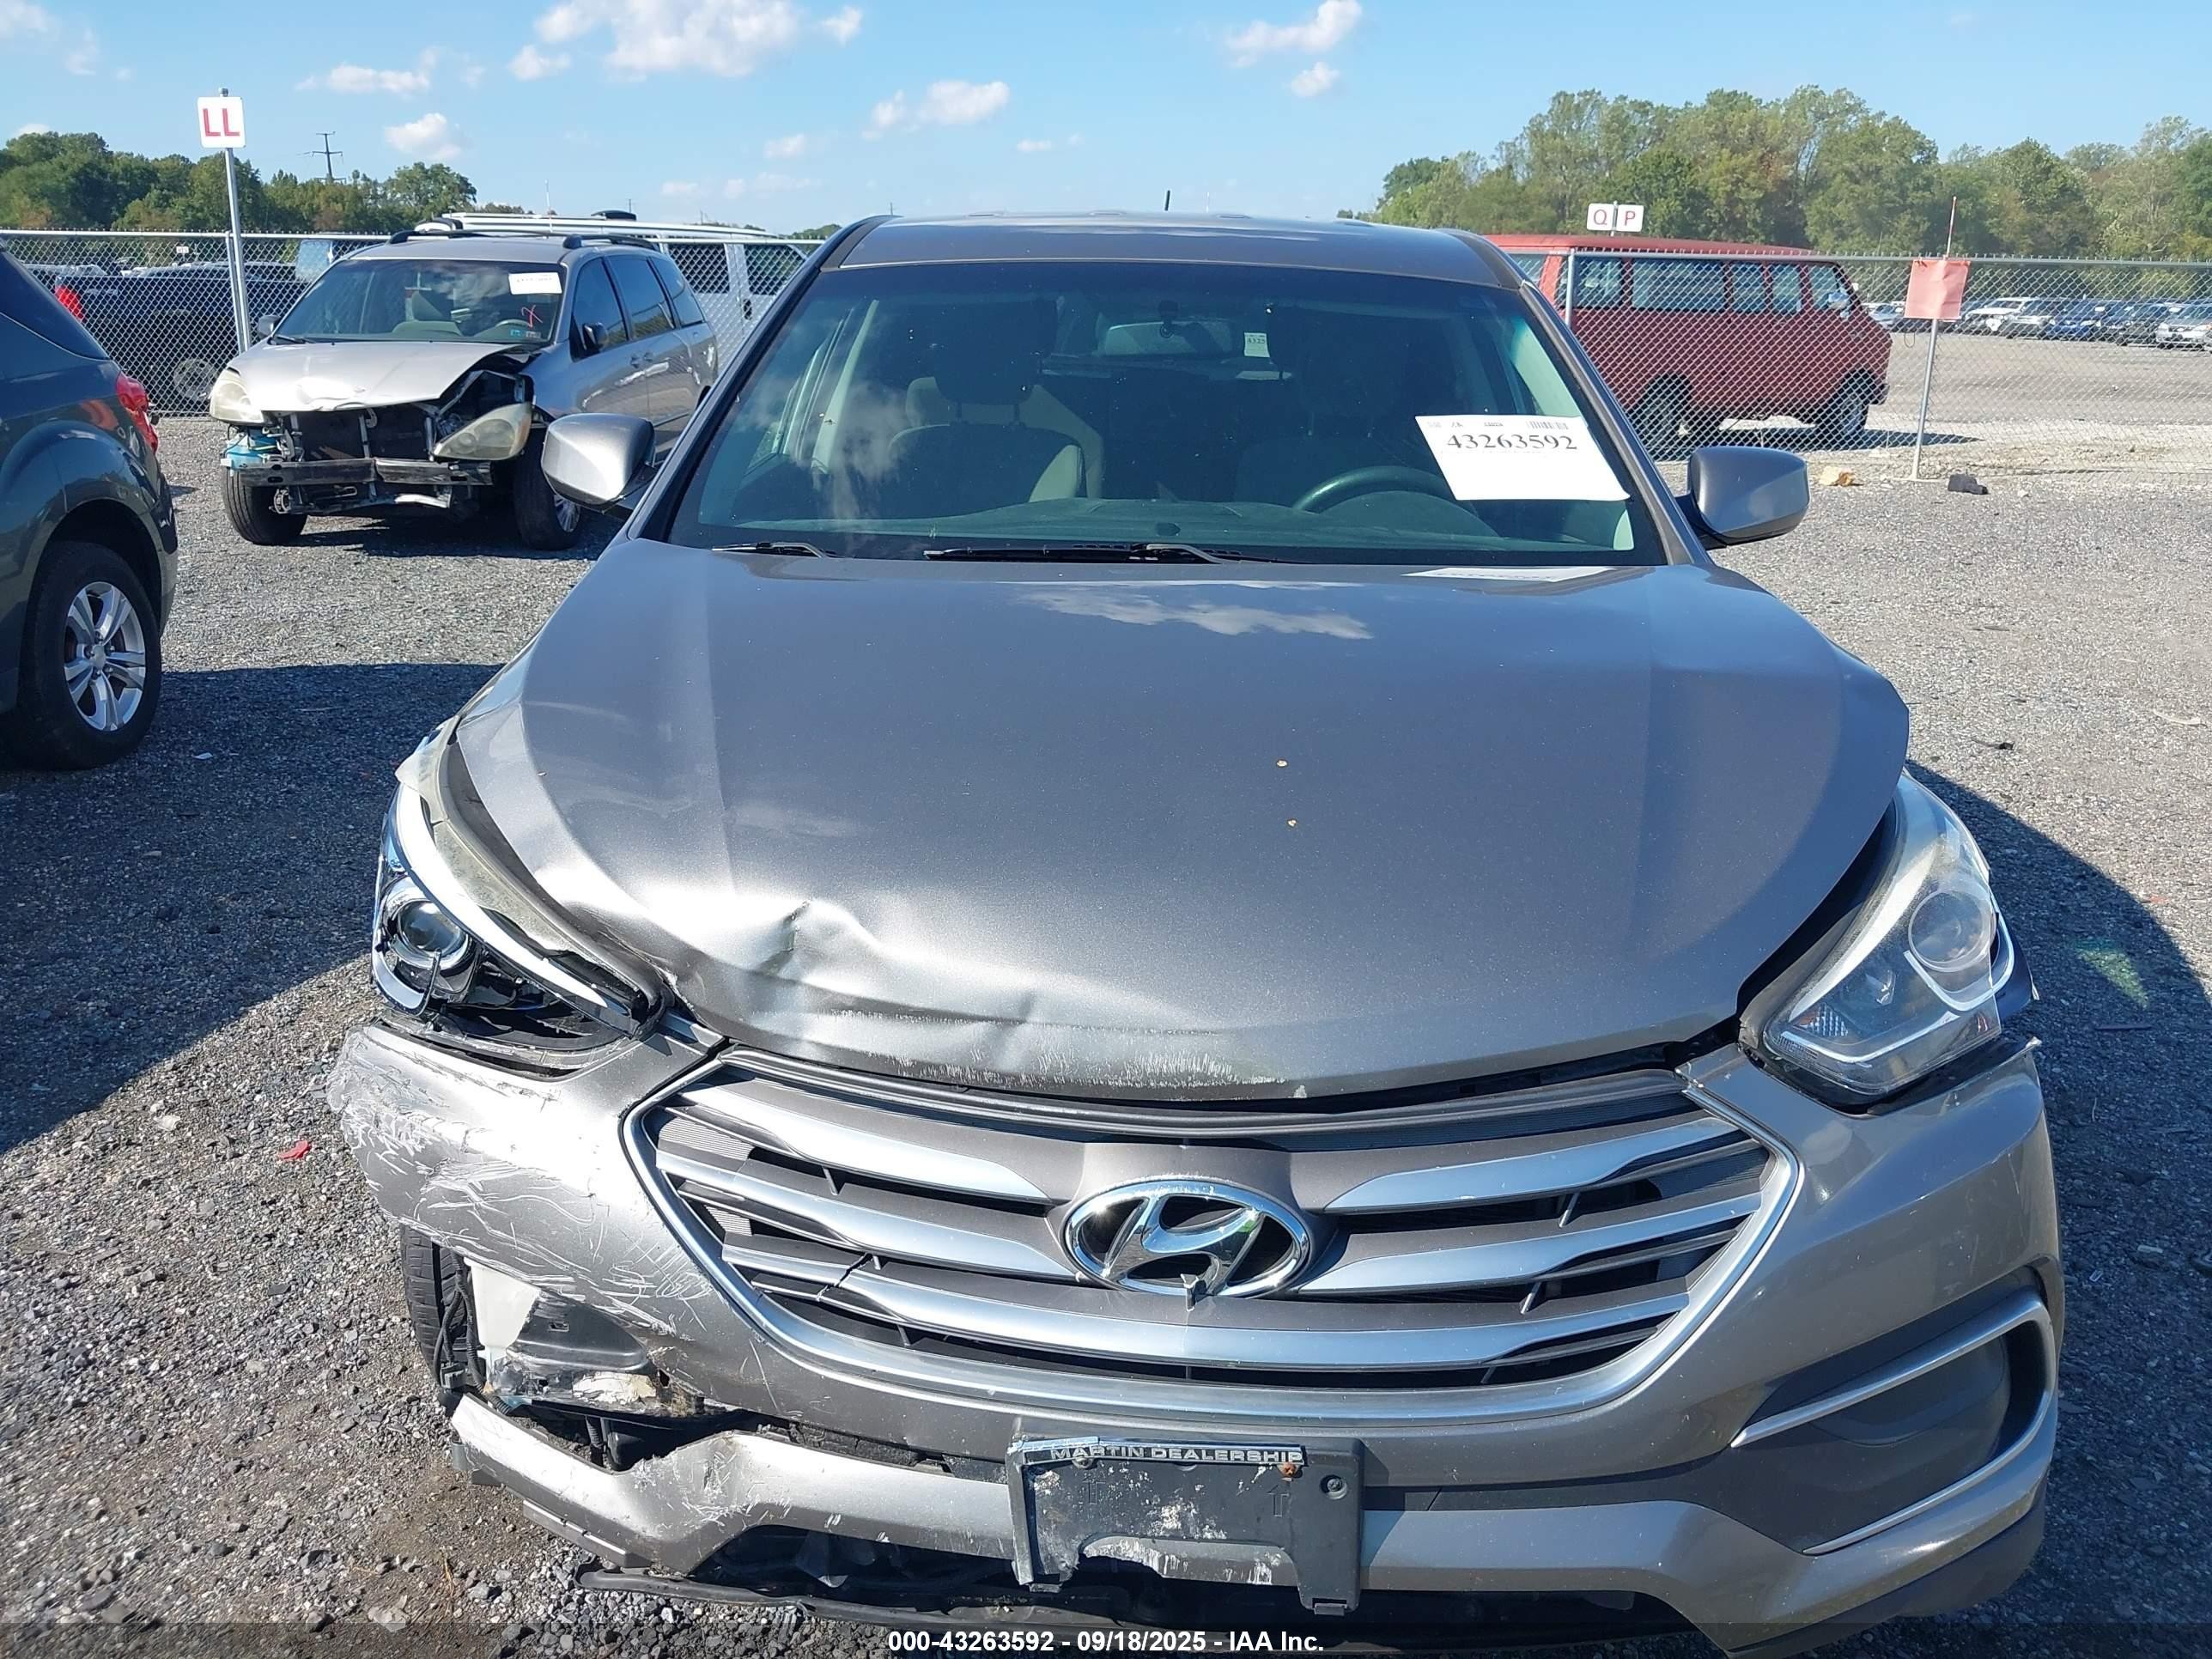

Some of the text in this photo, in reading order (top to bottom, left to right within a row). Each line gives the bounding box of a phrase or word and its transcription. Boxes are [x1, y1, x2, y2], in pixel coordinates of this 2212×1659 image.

[203, 107, 240, 137] LL
[1593, 209, 1607, 226] Q
[1624, 210, 1636, 226] P
[1446, 434, 1577, 450] 43263592
[1050, 1445, 1304, 1462] MARTIN DEALERSHIP
